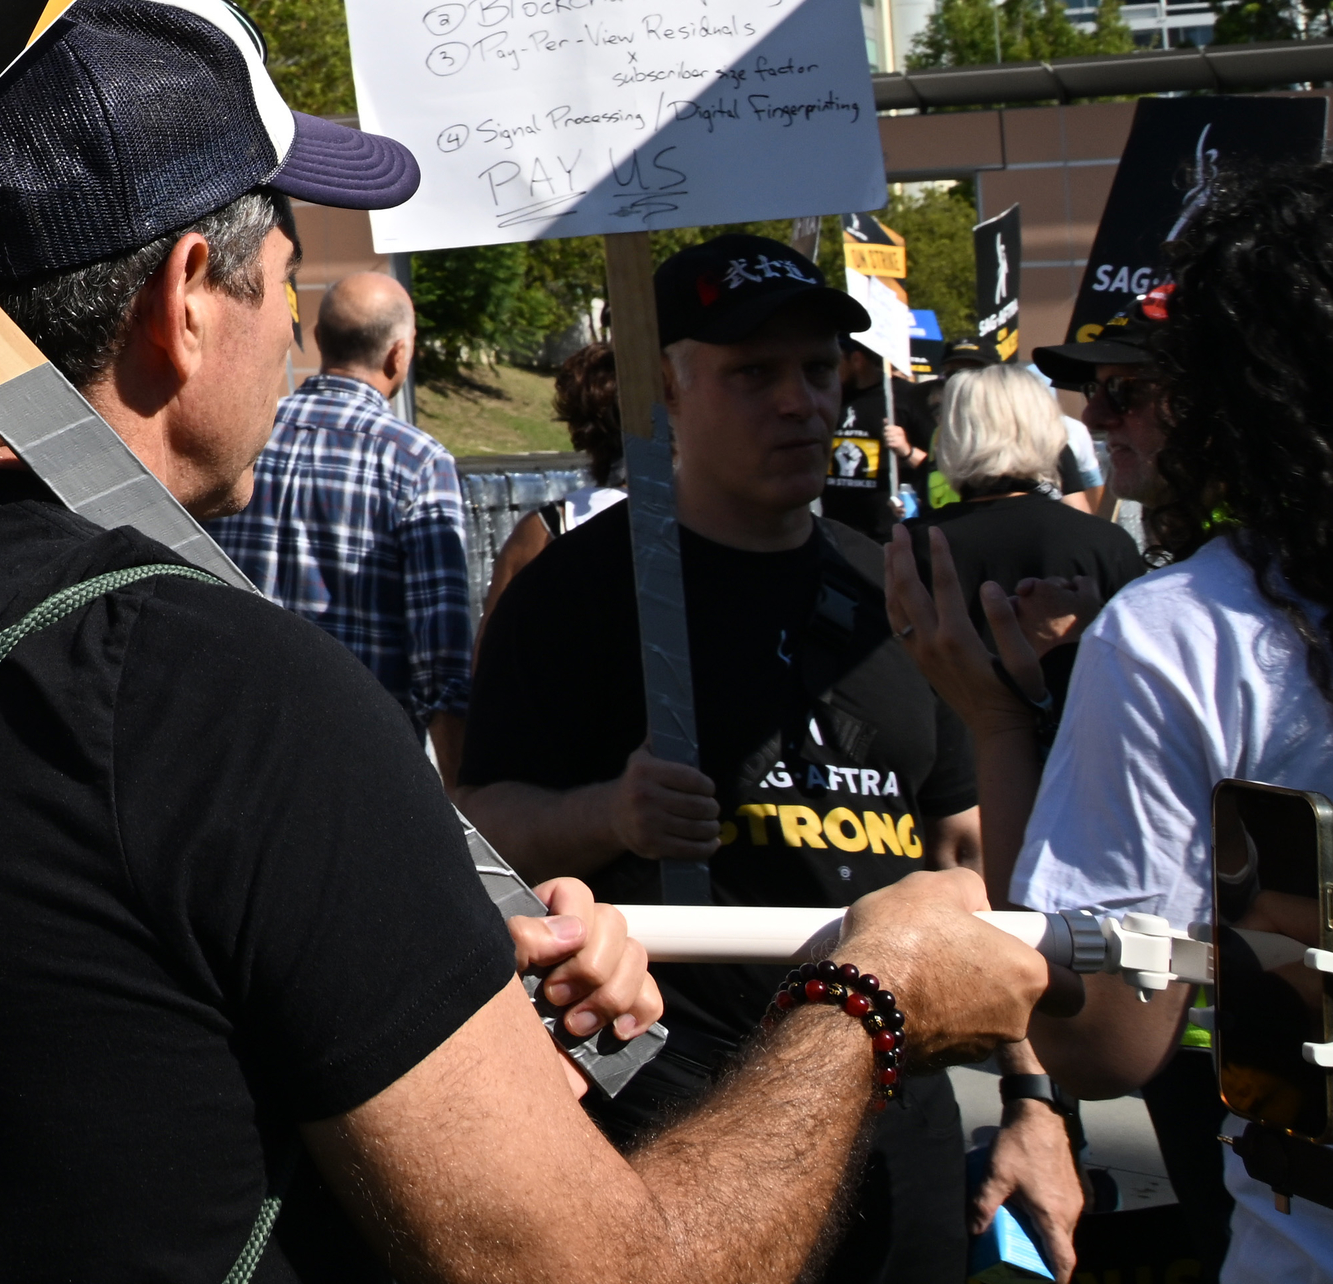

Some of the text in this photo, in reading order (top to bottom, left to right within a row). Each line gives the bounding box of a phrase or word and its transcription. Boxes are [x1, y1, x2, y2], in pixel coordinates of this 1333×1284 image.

[472, 21, 635, 70] Pay-Per-View
[641, 13, 757, 41] Residuals
[715, 67, 747, 89] size
[754, 56, 819, 82] factor
[475, 120, 542, 151] Signal
[545, 105, 647, 140] Processing
[667, 98, 740, 133] Digital
[748, 90, 861, 127] Fingerprinting
[477, 145, 688, 206] PAY US
